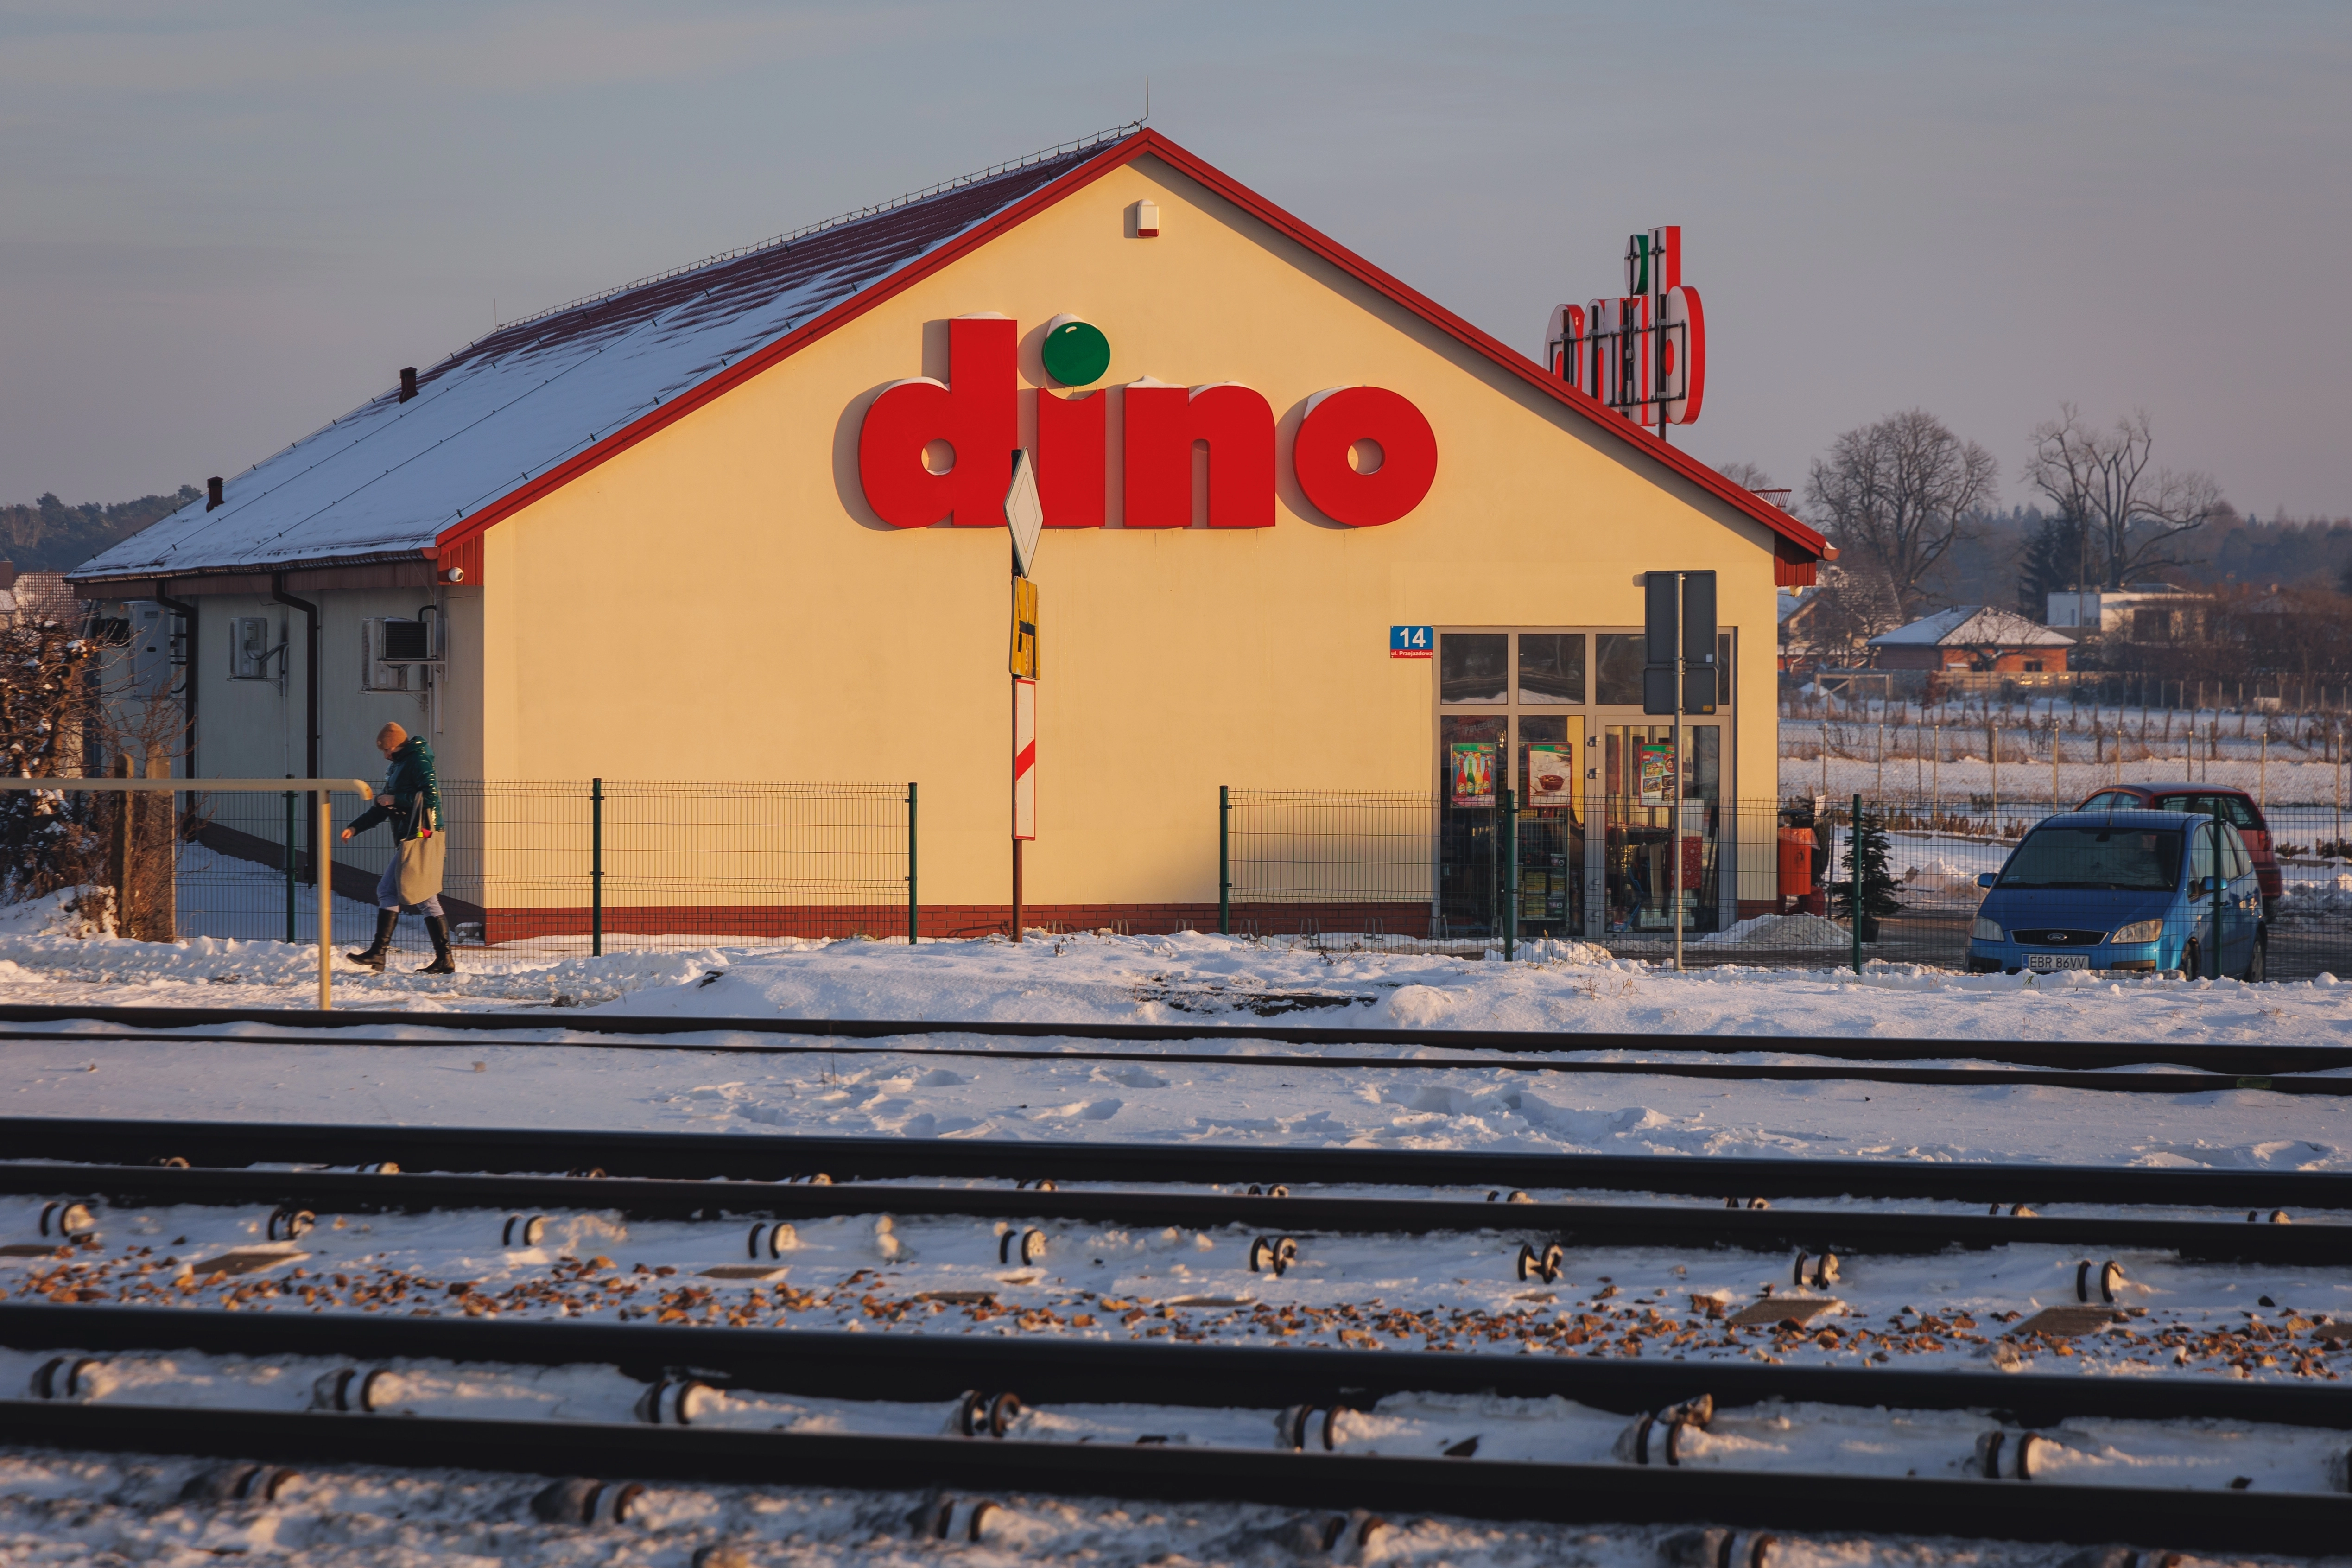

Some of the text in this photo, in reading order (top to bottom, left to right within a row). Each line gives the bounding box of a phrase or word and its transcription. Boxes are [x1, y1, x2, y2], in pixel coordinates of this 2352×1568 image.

[859, 318, 1438, 528] dino
[1400, 628, 1426, 647] 14
[2030, 956, 2085, 968] EBR 86VV
